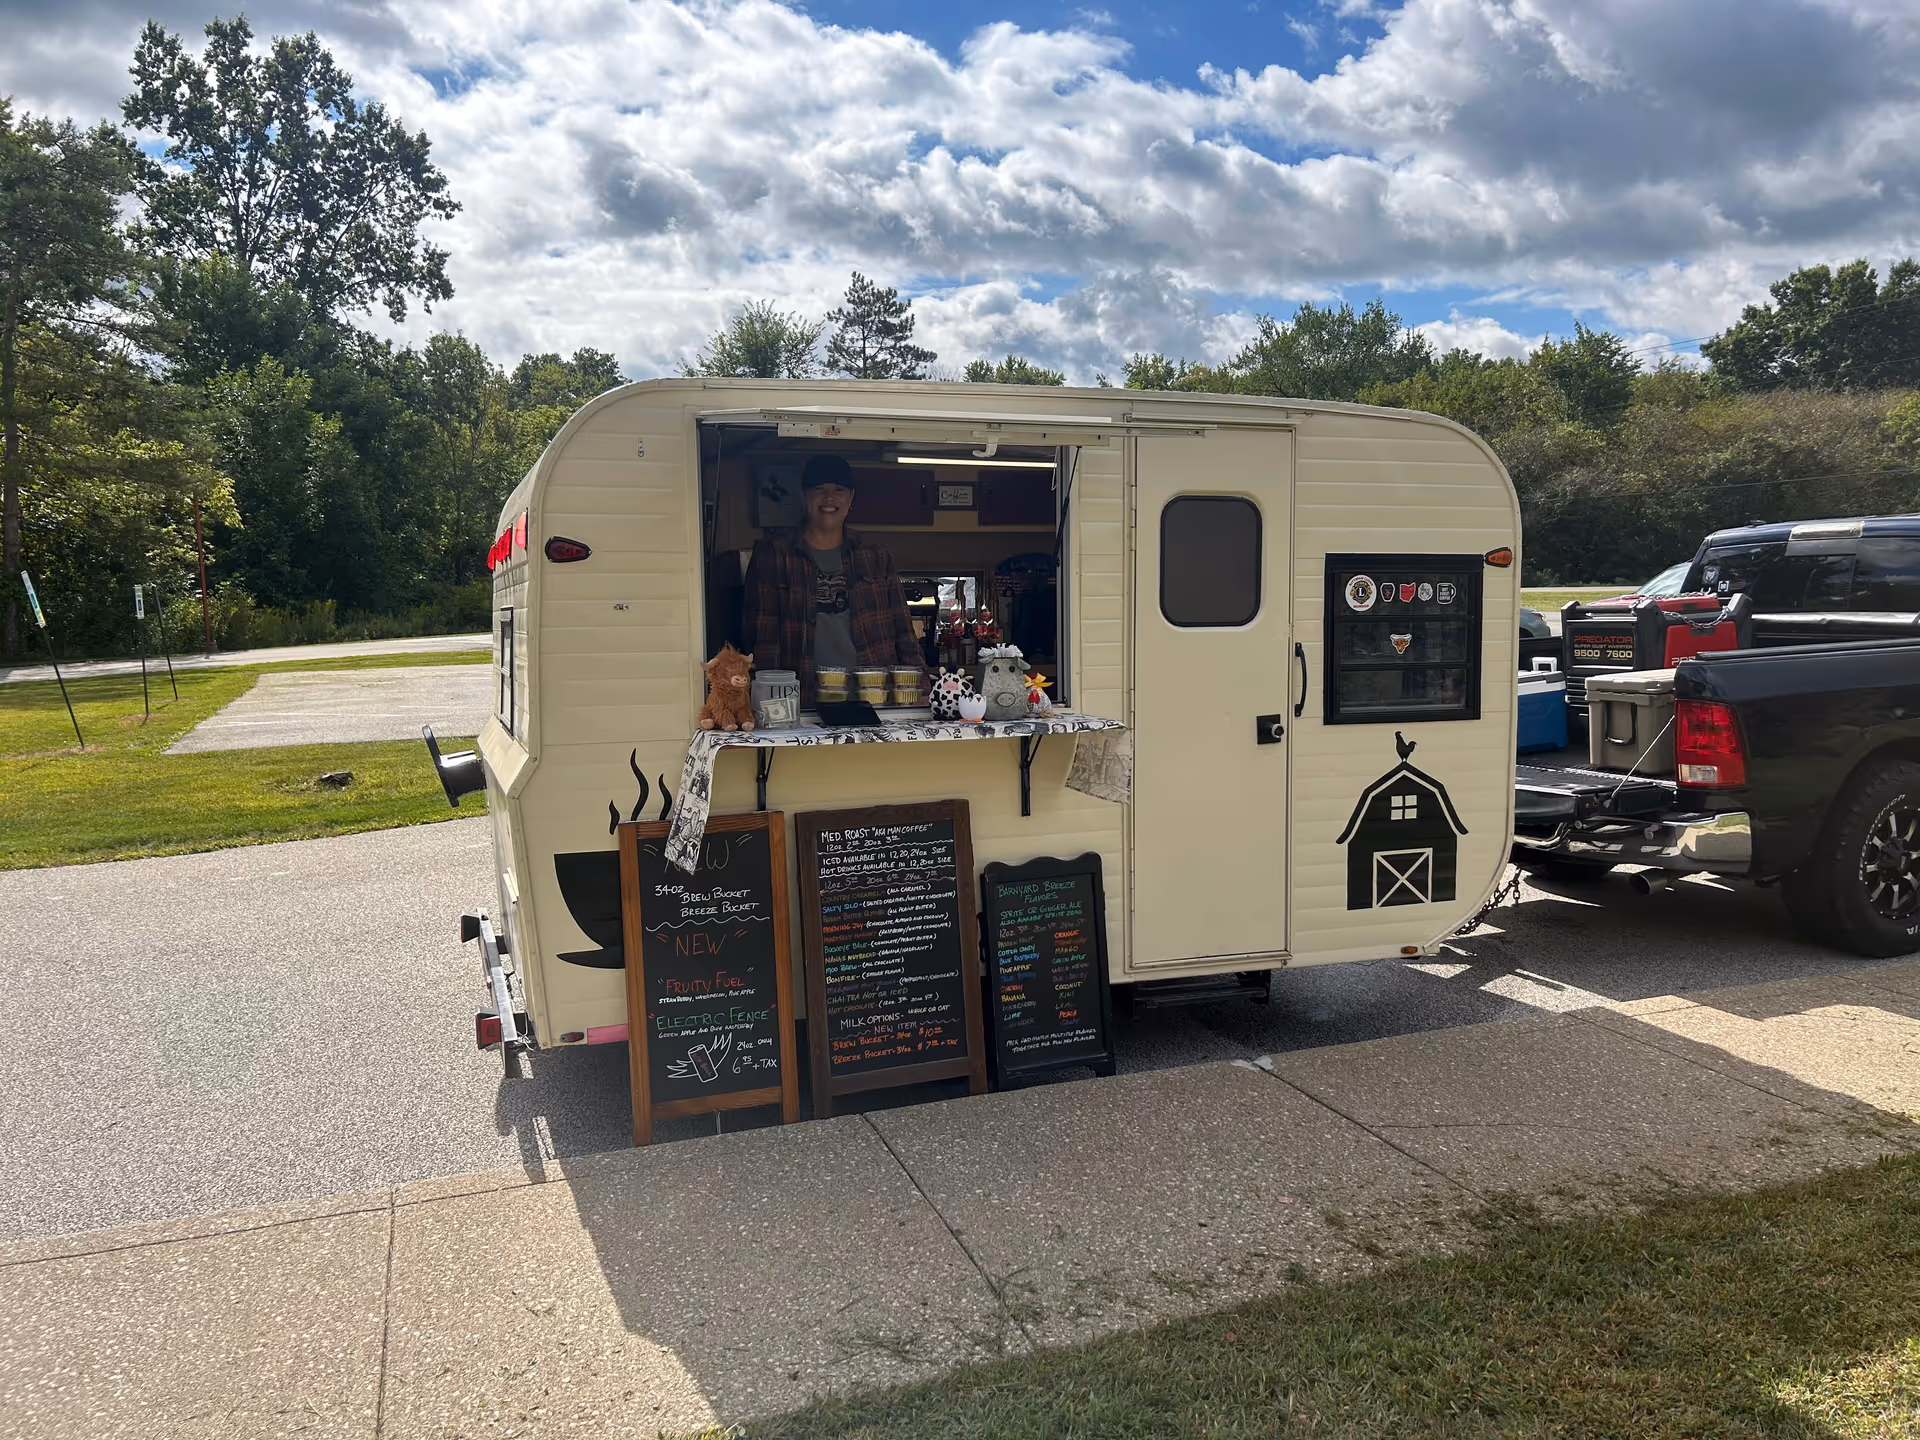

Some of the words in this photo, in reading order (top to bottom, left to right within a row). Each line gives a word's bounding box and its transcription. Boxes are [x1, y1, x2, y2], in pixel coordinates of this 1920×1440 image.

[767, 684, 800, 698] TIPS
[821, 831, 842, 843] MED.
[845, 828, 870, 840] ROAST
[887, 826, 901, 835] MAN
[823, 857, 841, 866] ICED
[843, 853, 876, 863] AVAILABLE
[931, 846, 947, 854] SIZE
[821, 866, 837, 875] HOT
[837, 864, 861, 873] DRINKS
[862, 862, 896, 870] AVAILABLE
[997, 884, 1039, 898] BARNYARD
[1043, 881, 1076, 891] BREEZE
[680, 892, 710, 904] BREW
[712, 887, 751, 899] BUCKET
[1024, 892, 1058, 903] FLAVORS
[680, 906, 718, 918] BREEZE
[722, 901, 760, 912] BUCKET
[822, 905, 842, 914] SALTY
[1000, 909, 1024, 920] SPRITE
[1040, 903, 1067, 913] GINGER
[823, 923, 851, 933] MORNING
[1054, 930, 1080, 939] ORANGE
[998, 948, 1018, 956] COTTON
[1055, 946, 1079, 954] MANGO
[1000, 964, 1032, 974] PINEAPPLE
[1055, 982, 1083, 990] COCONUT
[1001, 993, 1026, 1002] BANANA
[1059, 991, 1075, 999] KIWI
[1004, 1012, 1022, 1021] LIME
[1059, 1009, 1078, 1019] PEACH
[840, 1016, 866, 1029] MILK
[874, 1025, 894, 1034] NEW
[898, 1021, 917, 1030] ITEM
[758, 1038, 772, 1046] ONLY
[832, 1040, 856, 1051] BREW
[760, 1058, 777, 1068] TAX
[832, 1055, 861, 1065] BREEZE
